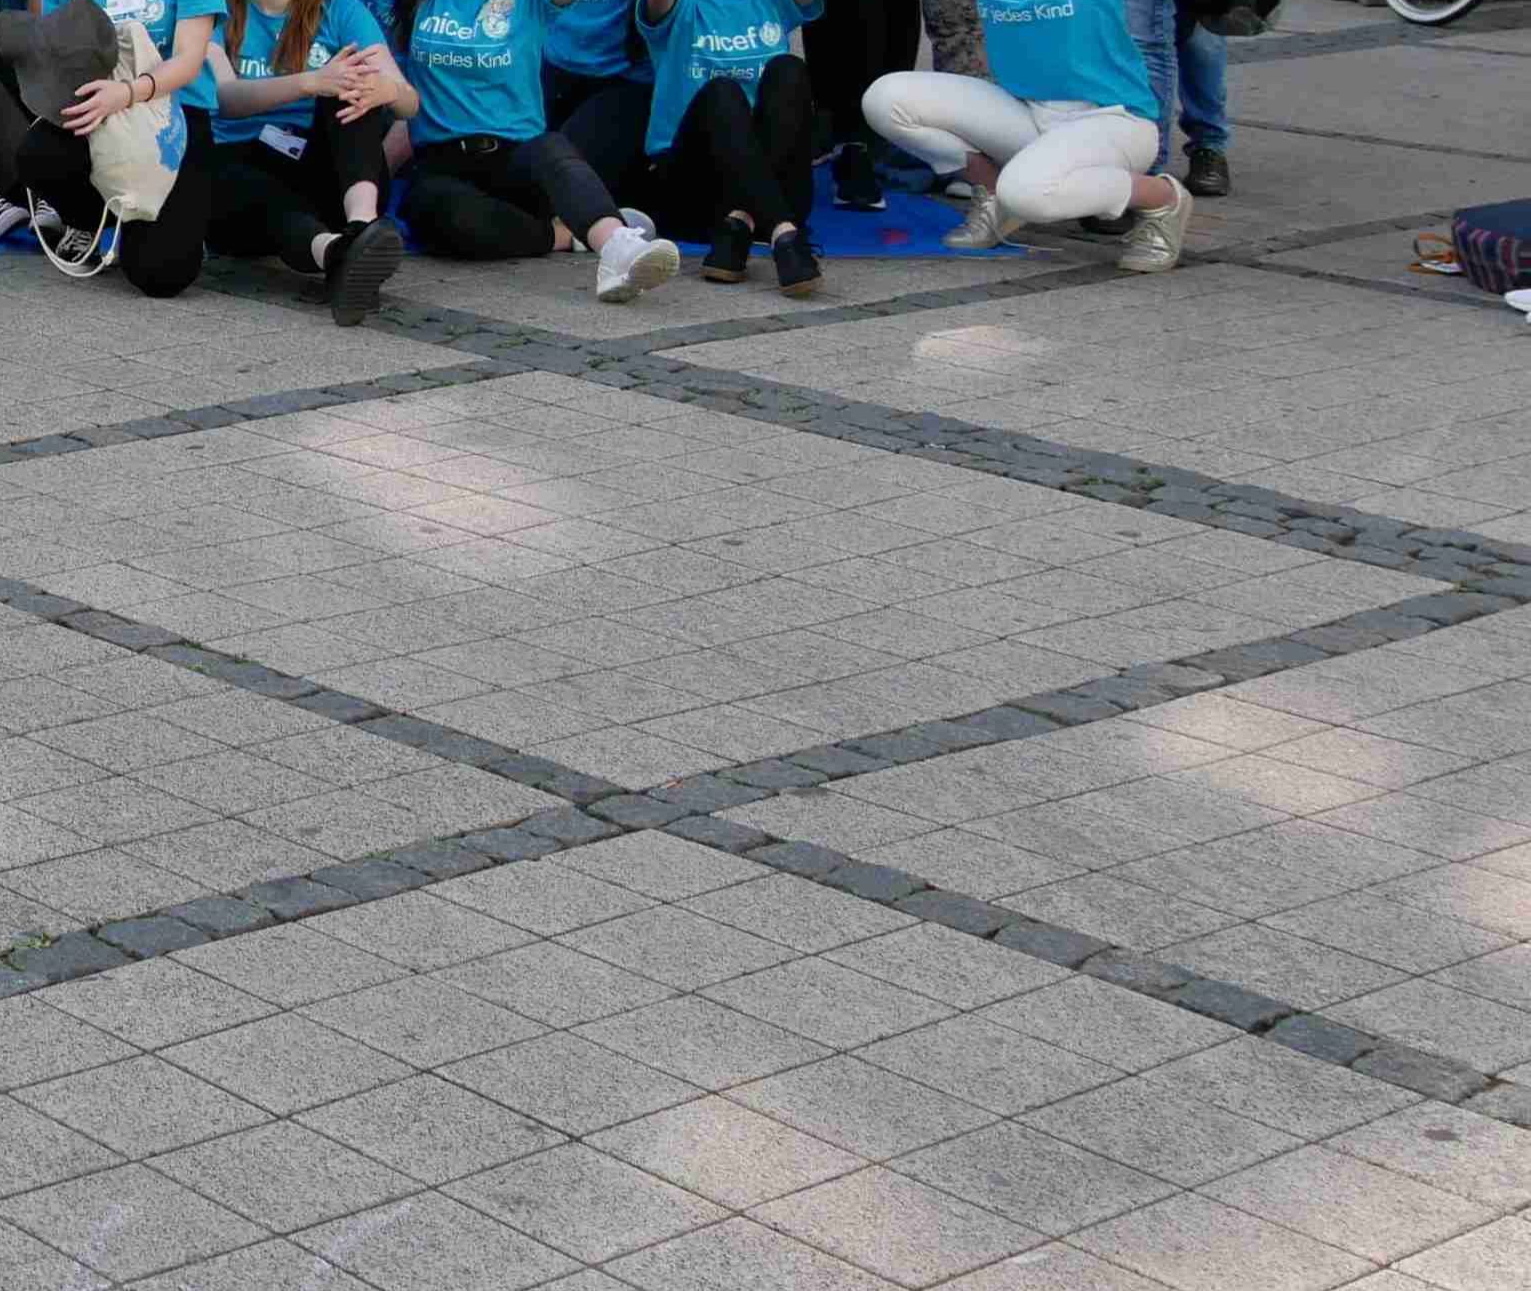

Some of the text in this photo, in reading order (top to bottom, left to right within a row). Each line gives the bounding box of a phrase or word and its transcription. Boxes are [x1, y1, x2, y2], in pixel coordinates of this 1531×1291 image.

[1035, 1, 1075, 20] Kind
[428, 50, 474, 72] jedes
[476, 48, 513, 68] Kind
